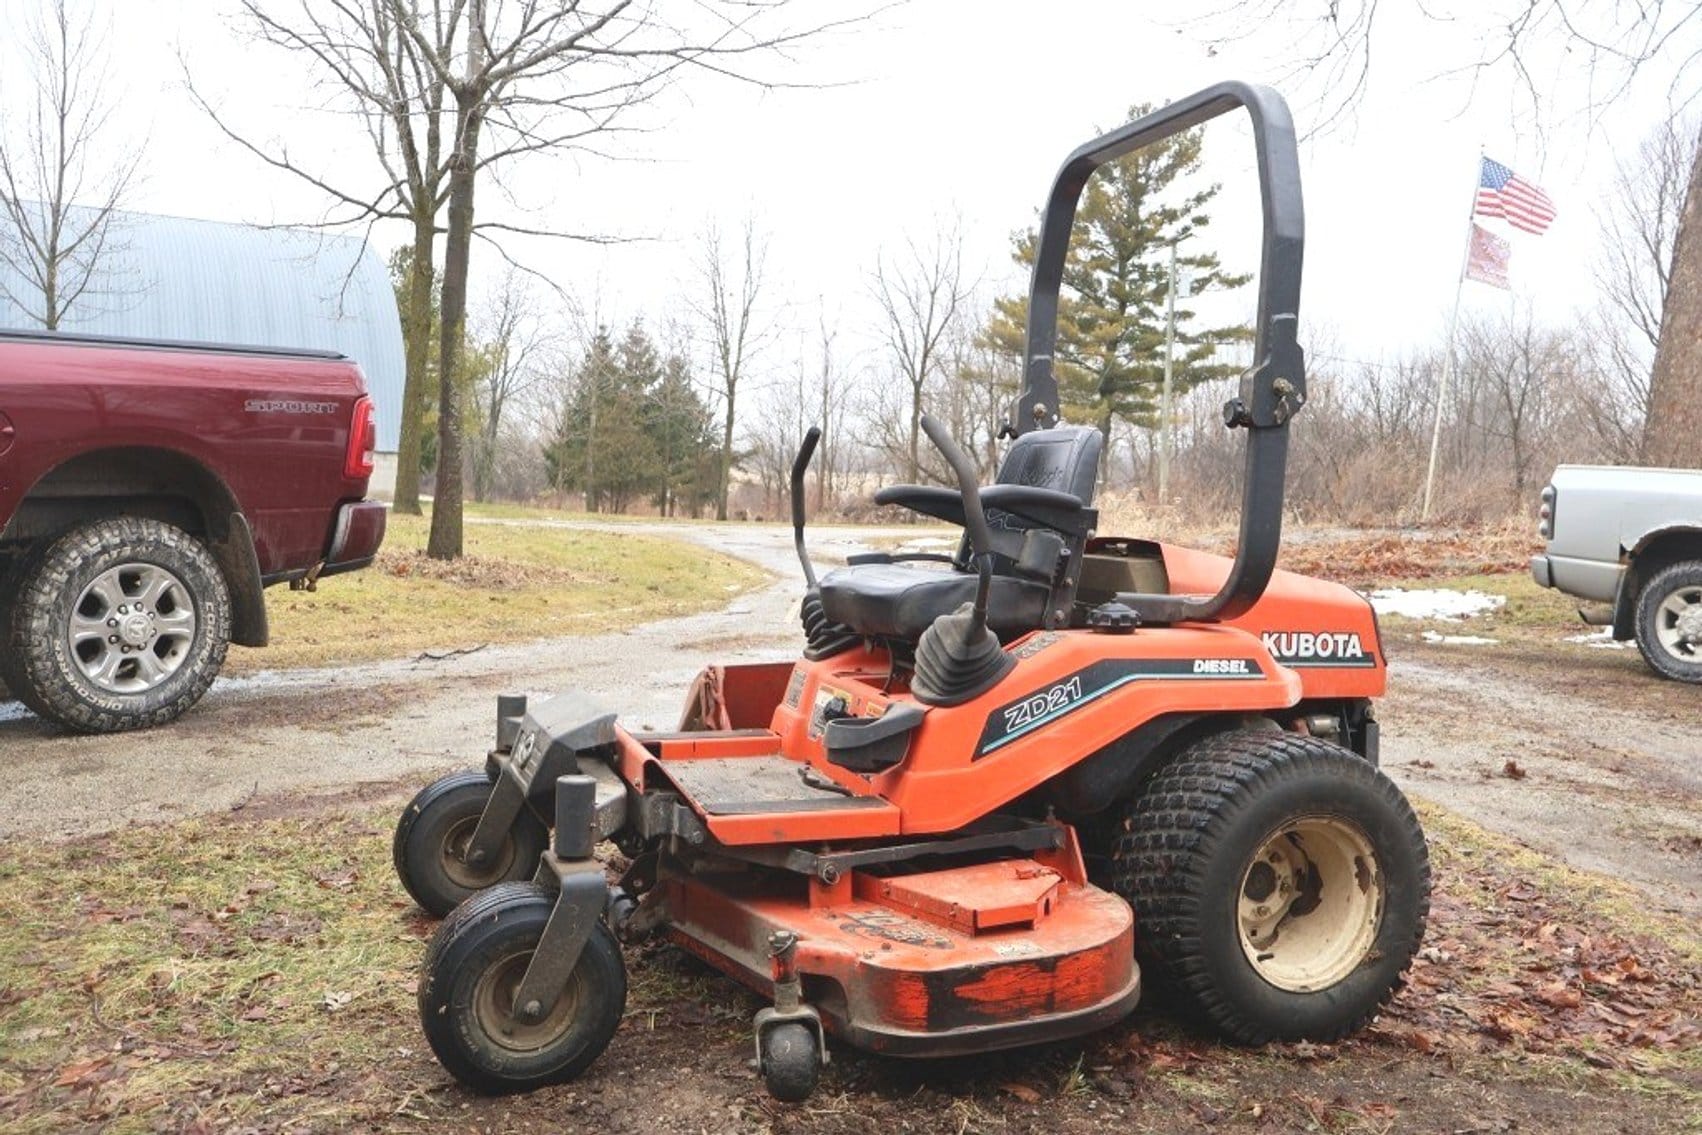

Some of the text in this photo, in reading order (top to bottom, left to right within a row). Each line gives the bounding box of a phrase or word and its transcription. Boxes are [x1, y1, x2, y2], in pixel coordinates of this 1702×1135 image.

[244, 399, 339, 414] SPORT
[1262, 632, 1363, 657] KUBOTA
[1193, 659, 1249, 673] DIESEL
[1004, 676, 1082, 733] ZD21
